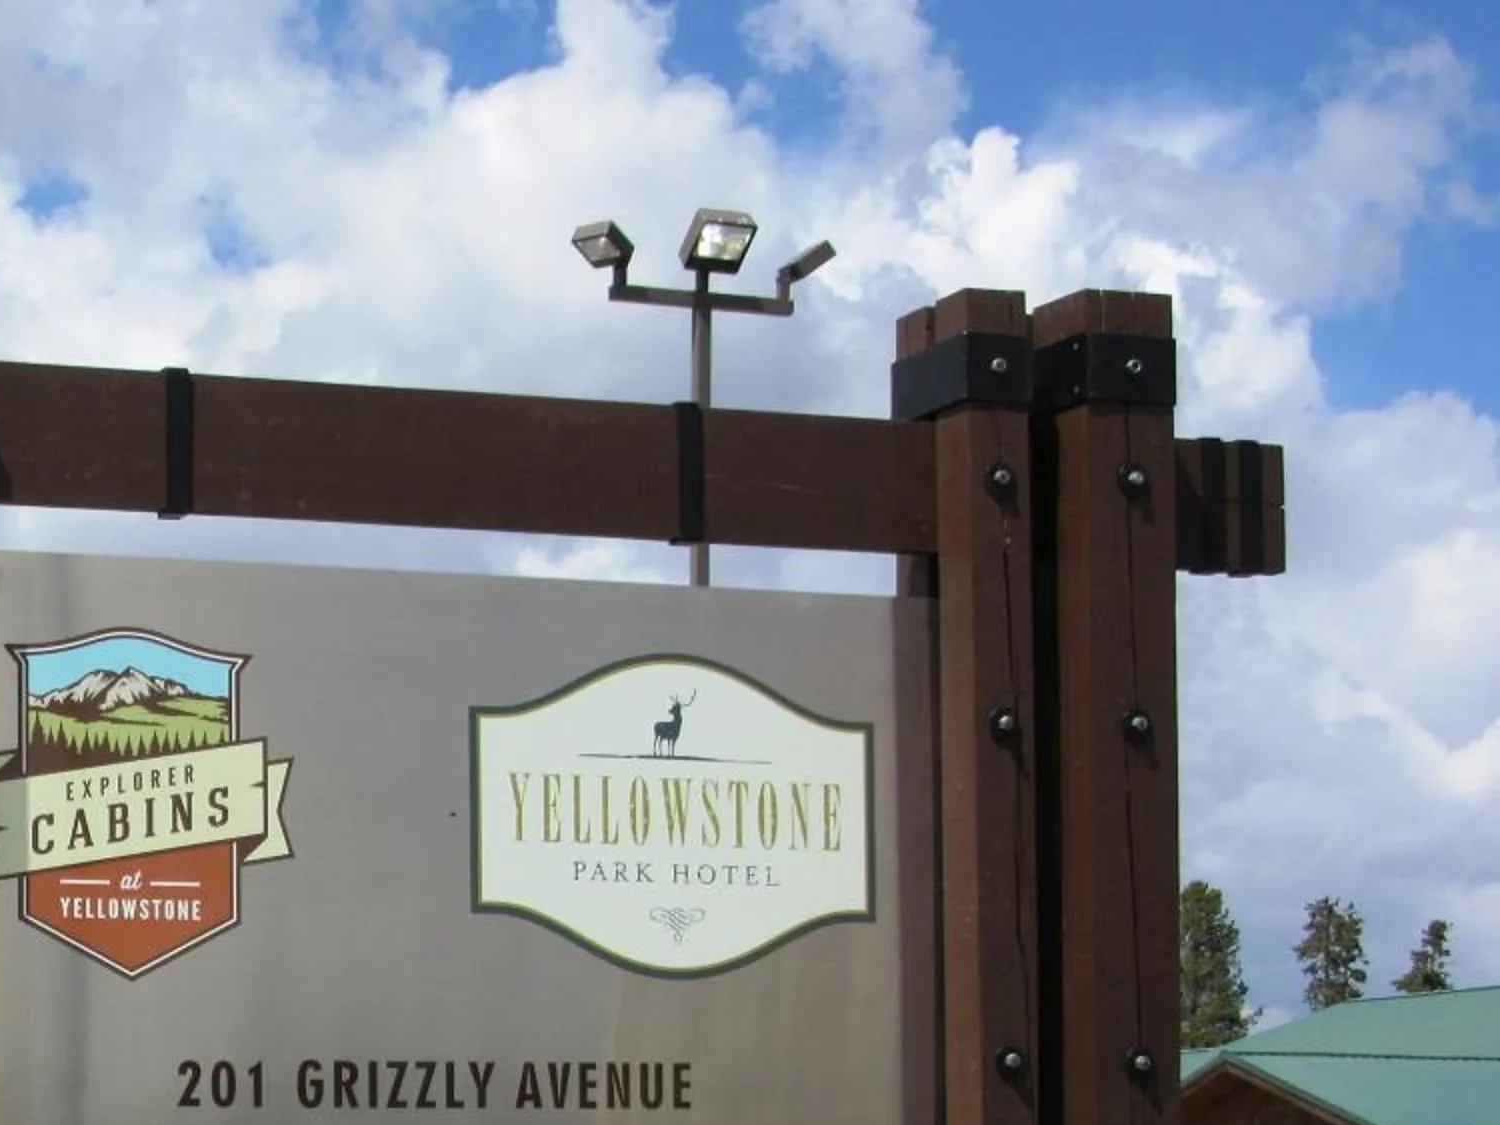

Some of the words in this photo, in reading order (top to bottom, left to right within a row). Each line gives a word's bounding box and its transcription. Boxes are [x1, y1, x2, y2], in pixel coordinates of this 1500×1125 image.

[66, 764, 195, 801] EXPLORER
[31, 786, 230, 855] CABINS
[508, 772, 842, 852] YELLOWSTONE
[119, 870, 143, 890] at
[573, 861, 655, 883] PARK
[672, 863, 782, 886] HOTEL
[60, 897, 202, 921] YELLOWSTONE
[177, 1060, 264, 1108] 201
[295, 1059, 495, 1109] GRIZZLY
[516, 1061, 692, 1109] AVENUE
